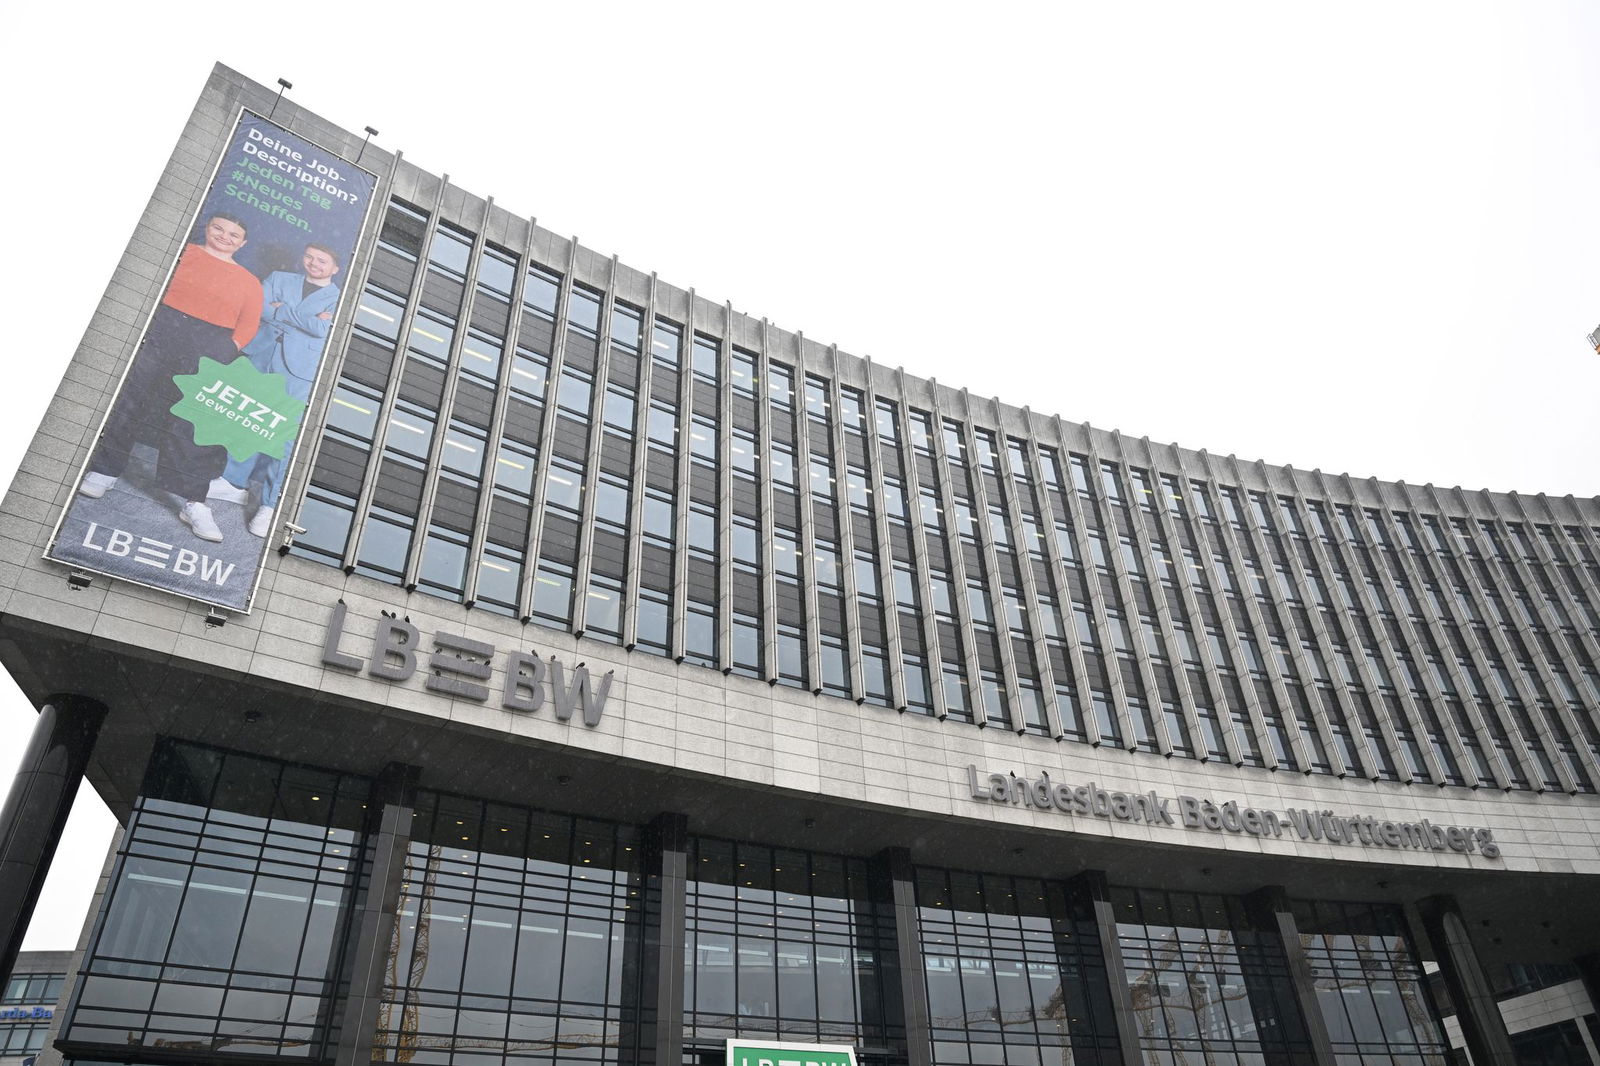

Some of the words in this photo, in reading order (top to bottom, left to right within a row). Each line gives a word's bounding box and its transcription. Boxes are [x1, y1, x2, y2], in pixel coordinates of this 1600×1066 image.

[242, 141, 358, 205] Description?
[248, 128, 303, 162] Deine
[306, 160, 347, 182] Job-
[224, 183, 313, 233] Schaffen.
[231, 170, 303, 211] #Neues
[236, 157, 295, 190] Jeden
[301, 185, 332, 210] Tag
[194, 391, 276, 441] bewerben!
[201, 379, 288, 429] JETZT
[967, 764, 1176, 825] Landesbank
[1178, 795, 1501, 858] Baden-Württemberg
